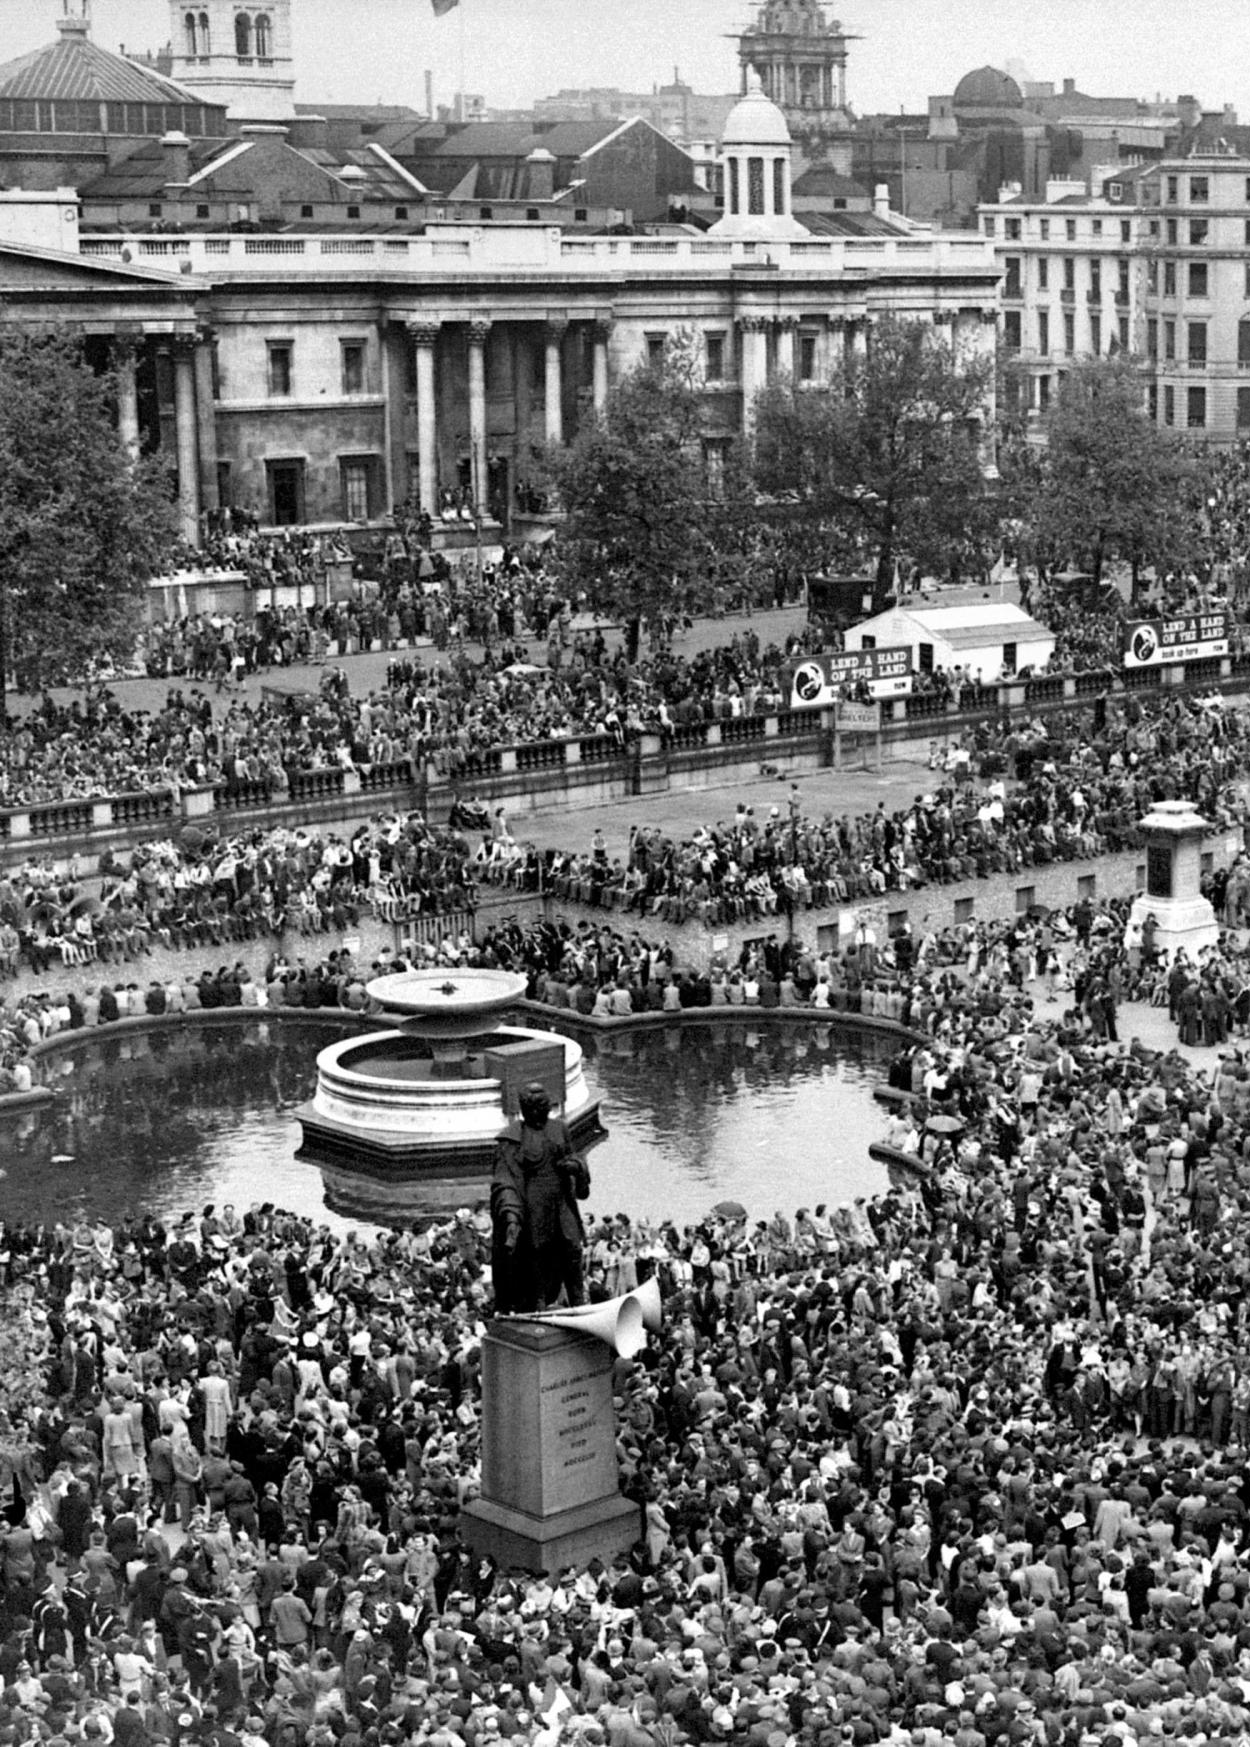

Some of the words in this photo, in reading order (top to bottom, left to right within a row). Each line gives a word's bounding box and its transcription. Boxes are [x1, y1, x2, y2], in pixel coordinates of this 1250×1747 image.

[1163, 620, 1186, 633] LEND
[1190, 619, 1197, 630] A
[1200, 616, 1225, 629] HAND
[1162, 633, 1175, 644] ON
[1179, 630, 1197, 642] THE
[1201, 627, 1225, 640] LAND
[831, 657, 859, 670] LEND
[864, 654, 873, 666] A
[877, 651, 907, 665] HAND
[831, 670, 846, 682] ON
[851, 667, 873, 680] THE
[879, 663, 907, 677] LAND
